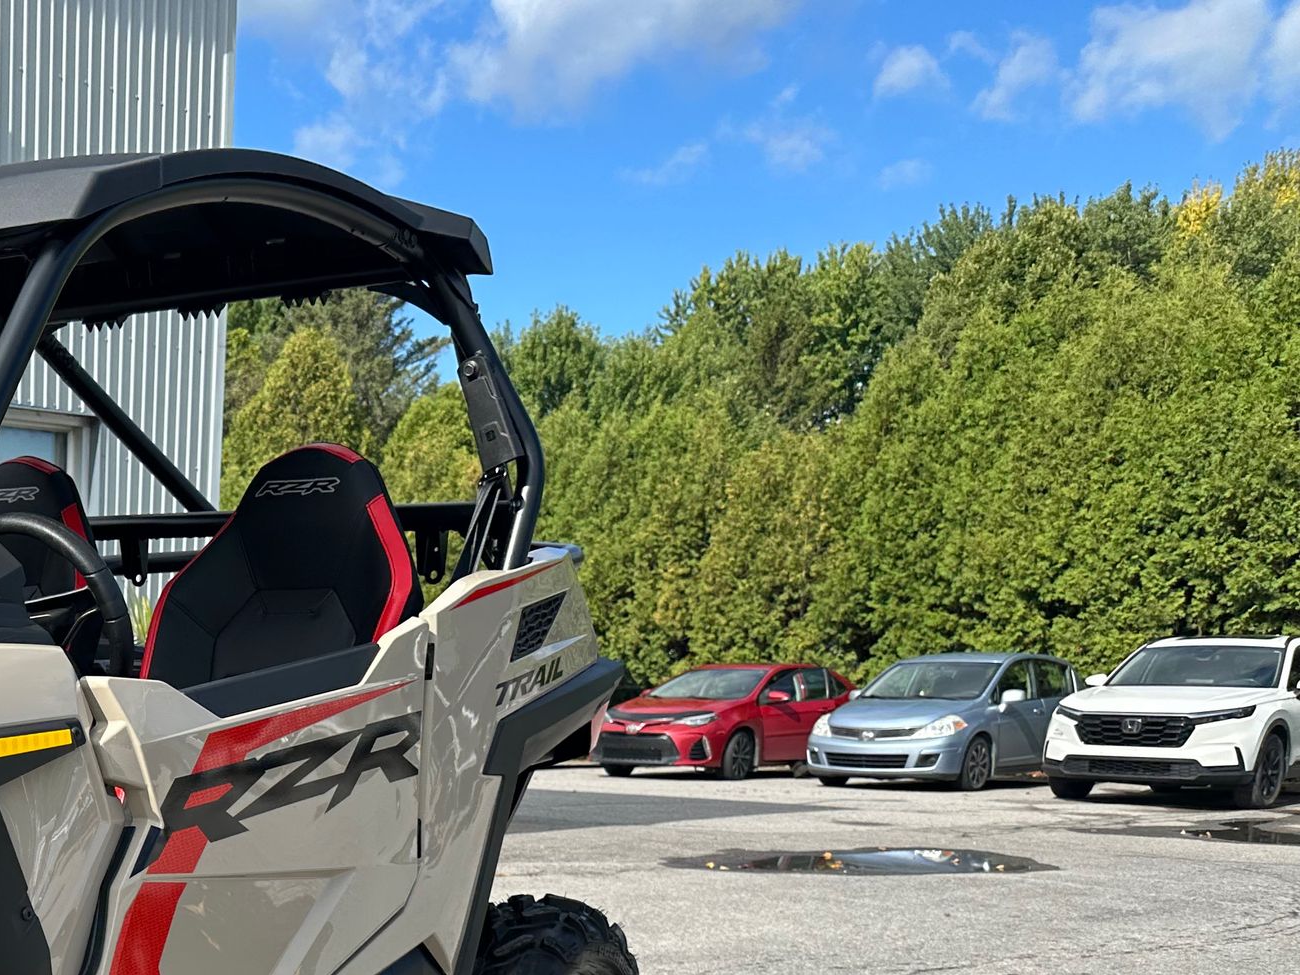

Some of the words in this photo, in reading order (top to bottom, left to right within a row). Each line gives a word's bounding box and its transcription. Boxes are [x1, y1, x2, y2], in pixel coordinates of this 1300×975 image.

[255, 476, 340, 498] RZR
[495, 656, 564, 708] TRAIL
[129, 710, 422, 879] RZR
